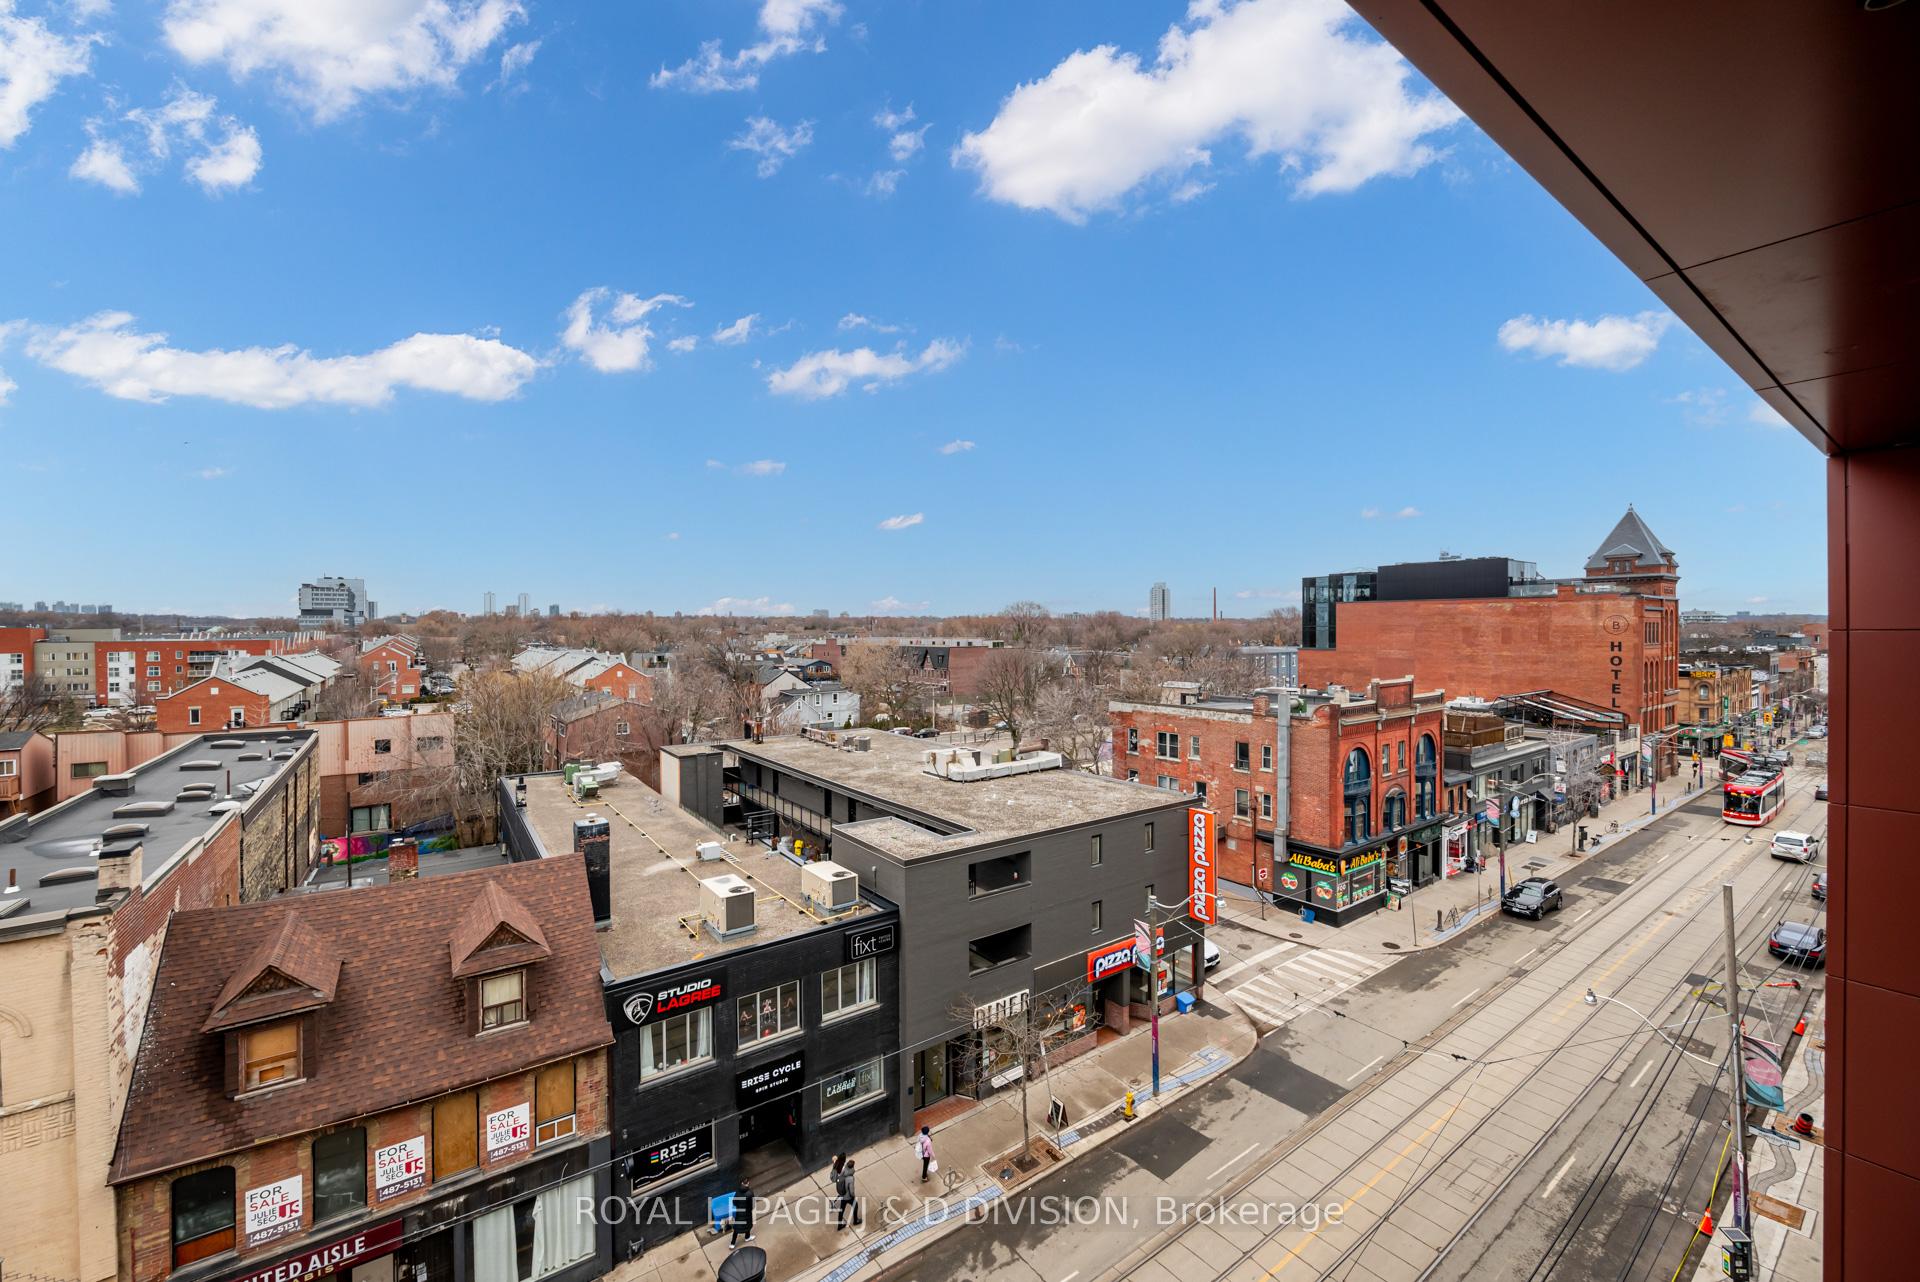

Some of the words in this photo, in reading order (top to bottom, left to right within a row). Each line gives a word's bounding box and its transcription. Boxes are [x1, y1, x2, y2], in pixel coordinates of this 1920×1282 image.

[1610, 641, 1622, 708] HOTEL
[1193, 813, 1210, 867] pizza
[1193, 867, 1210, 921] pizza
[854, 936, 877, 956] fixt
[1095, 949, 1131, 978] pizza
[657, 978, 712, 1001] STUDIO
[657, 985, 721, 1013] LAGREE
[976, 992, 1029, 1028] DINER
[772, 1060, 801, 1077] CYCLE
[490, 1111, 515, 1124] FOR
[490, 1116, 520, 1132] SALE
[491, 1129, 510, 1140] JULIE
[495, 1135, 510, 1144] SEO
[378, 1144, 407, 1160] FOR
[378, 1150, 415, 1168] SALE
[380, 1164, 403, 1177] JULIE
[386, 1171, 403, 1181] SEO
[250, 1186, 282, 1202] FOR
[250, 1192, 289, 1212] SALE
[251, 1206, 277, 1221] JULIE
[257, 1215, 277, 1226] SEO
[307, 1236, 366, 1272] AISLE
